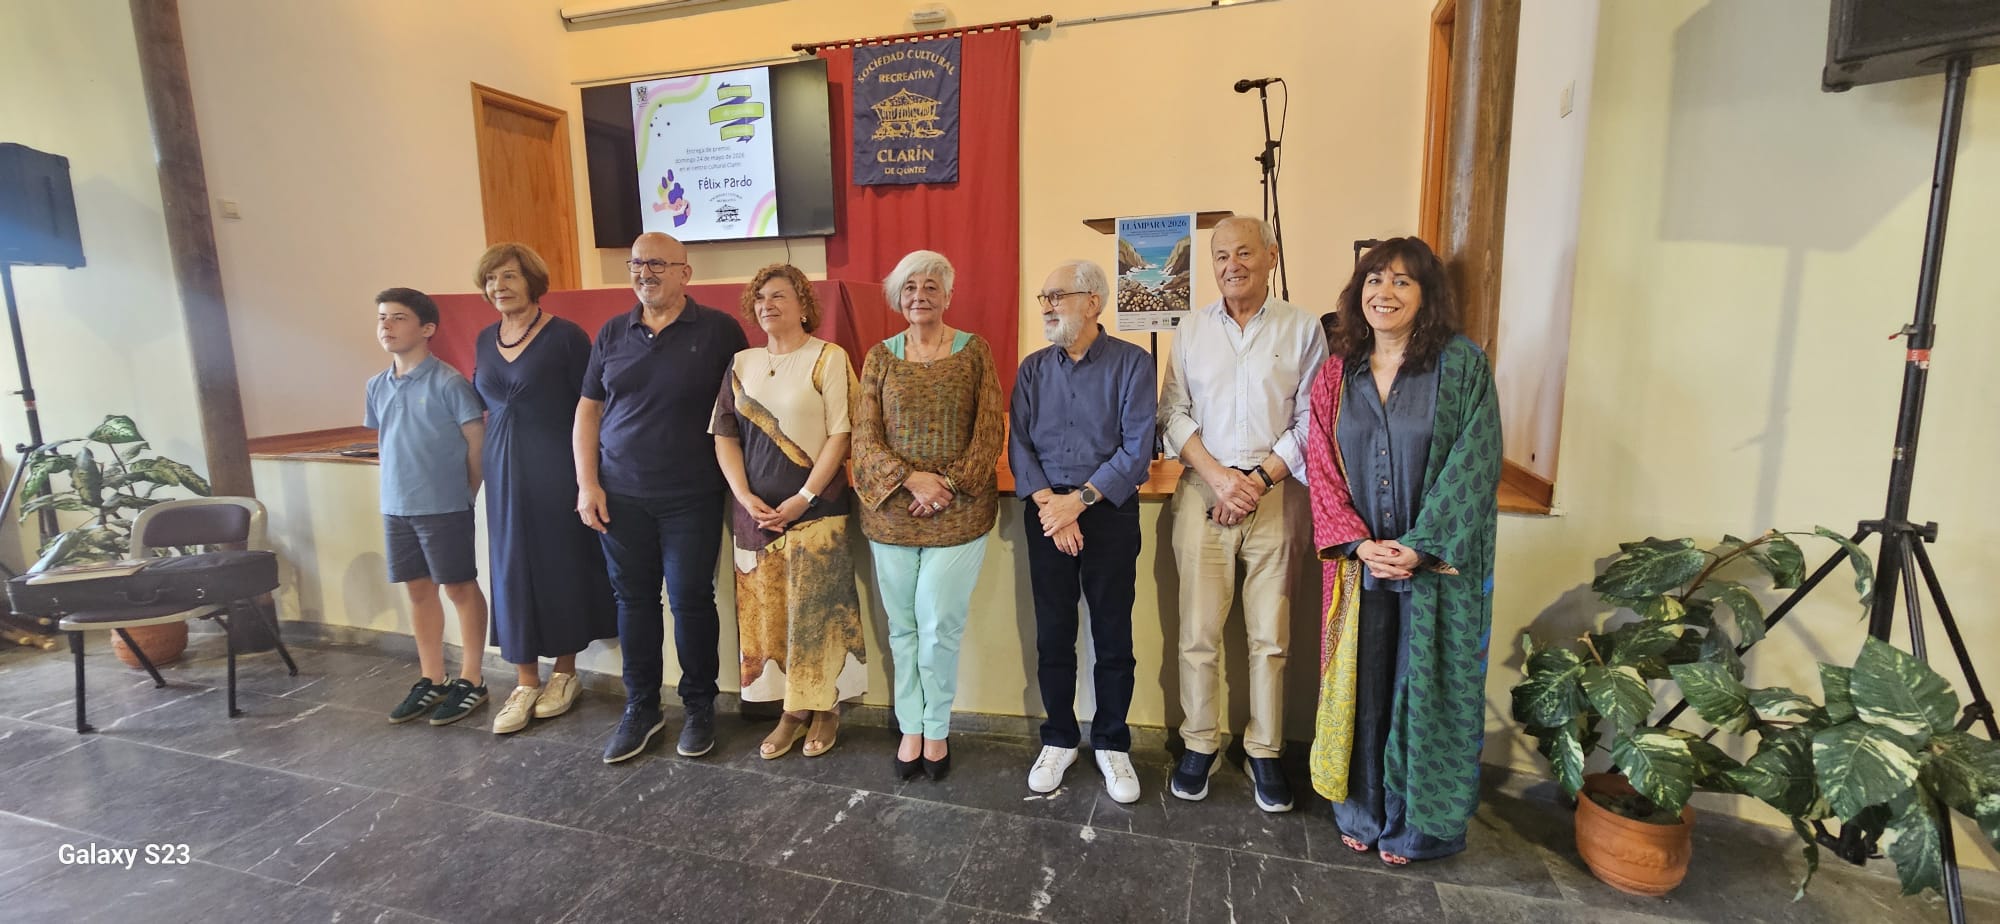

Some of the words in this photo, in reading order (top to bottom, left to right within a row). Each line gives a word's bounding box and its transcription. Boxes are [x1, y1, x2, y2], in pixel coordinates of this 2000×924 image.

[858, 50, 905, 83] SOCIEDAD
[907, 49, 956, 76] CULTURAL
[879, 68, 935, 83] RECREATIVA
[877, 144, 934, 163] CLARÍN
[884, 167, 895, 175] DE
[897, 165, 927, 176] QUINTES
[698, 177, 721, 190] Félix
[724, 174, 752, 189] Pardo
[1167, 219, 1187, 228] 2026
